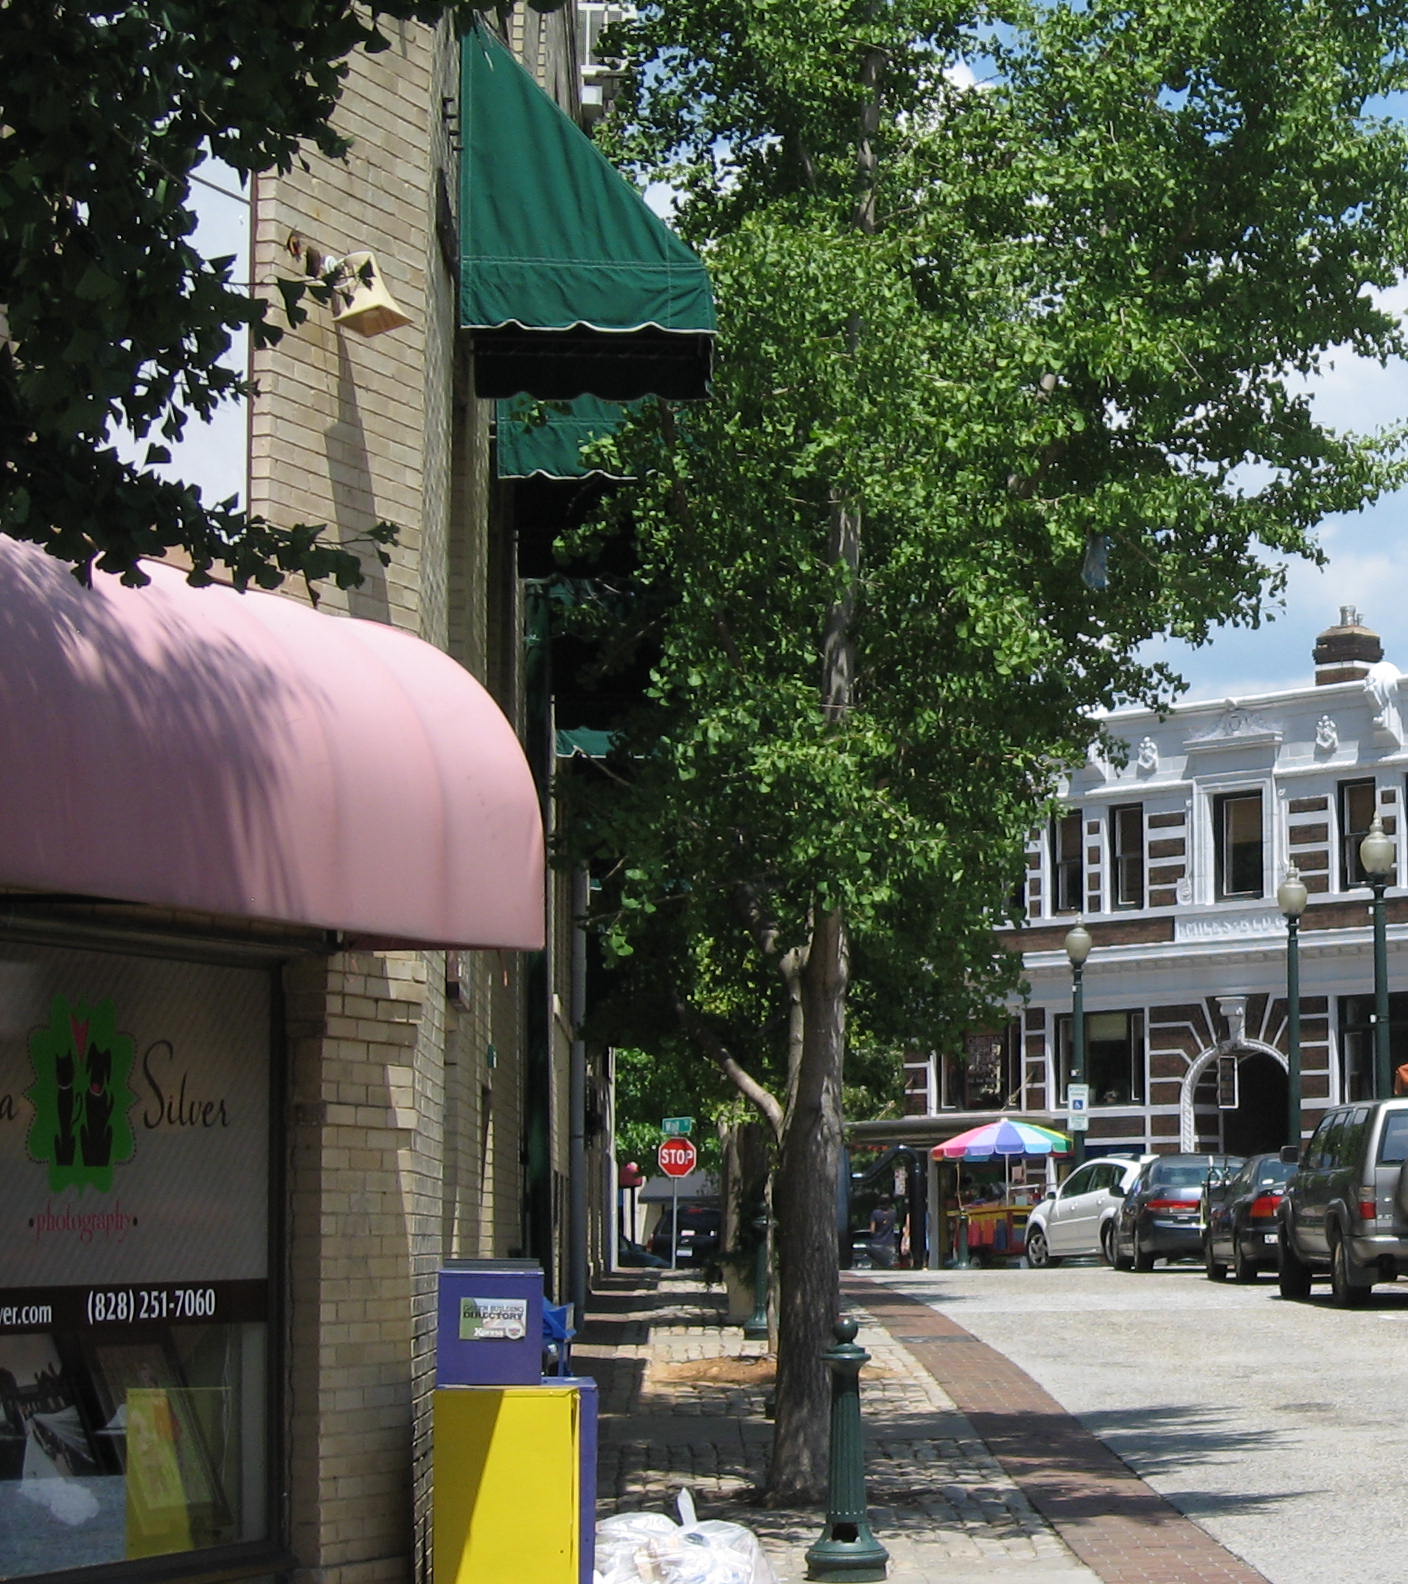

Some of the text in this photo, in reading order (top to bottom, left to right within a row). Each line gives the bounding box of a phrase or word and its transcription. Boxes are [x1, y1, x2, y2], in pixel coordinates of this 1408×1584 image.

[143, 1039, 230, 1129] Silver
[661, 1149, 693, 1165] STOP
[35, 1200, 131, 1243] photography
[87, 1290, 135, 1325] (828)
[139, 1288, 216, 1319] 251-7060
[463, 1311, 524, 1320] DIRECTORY
